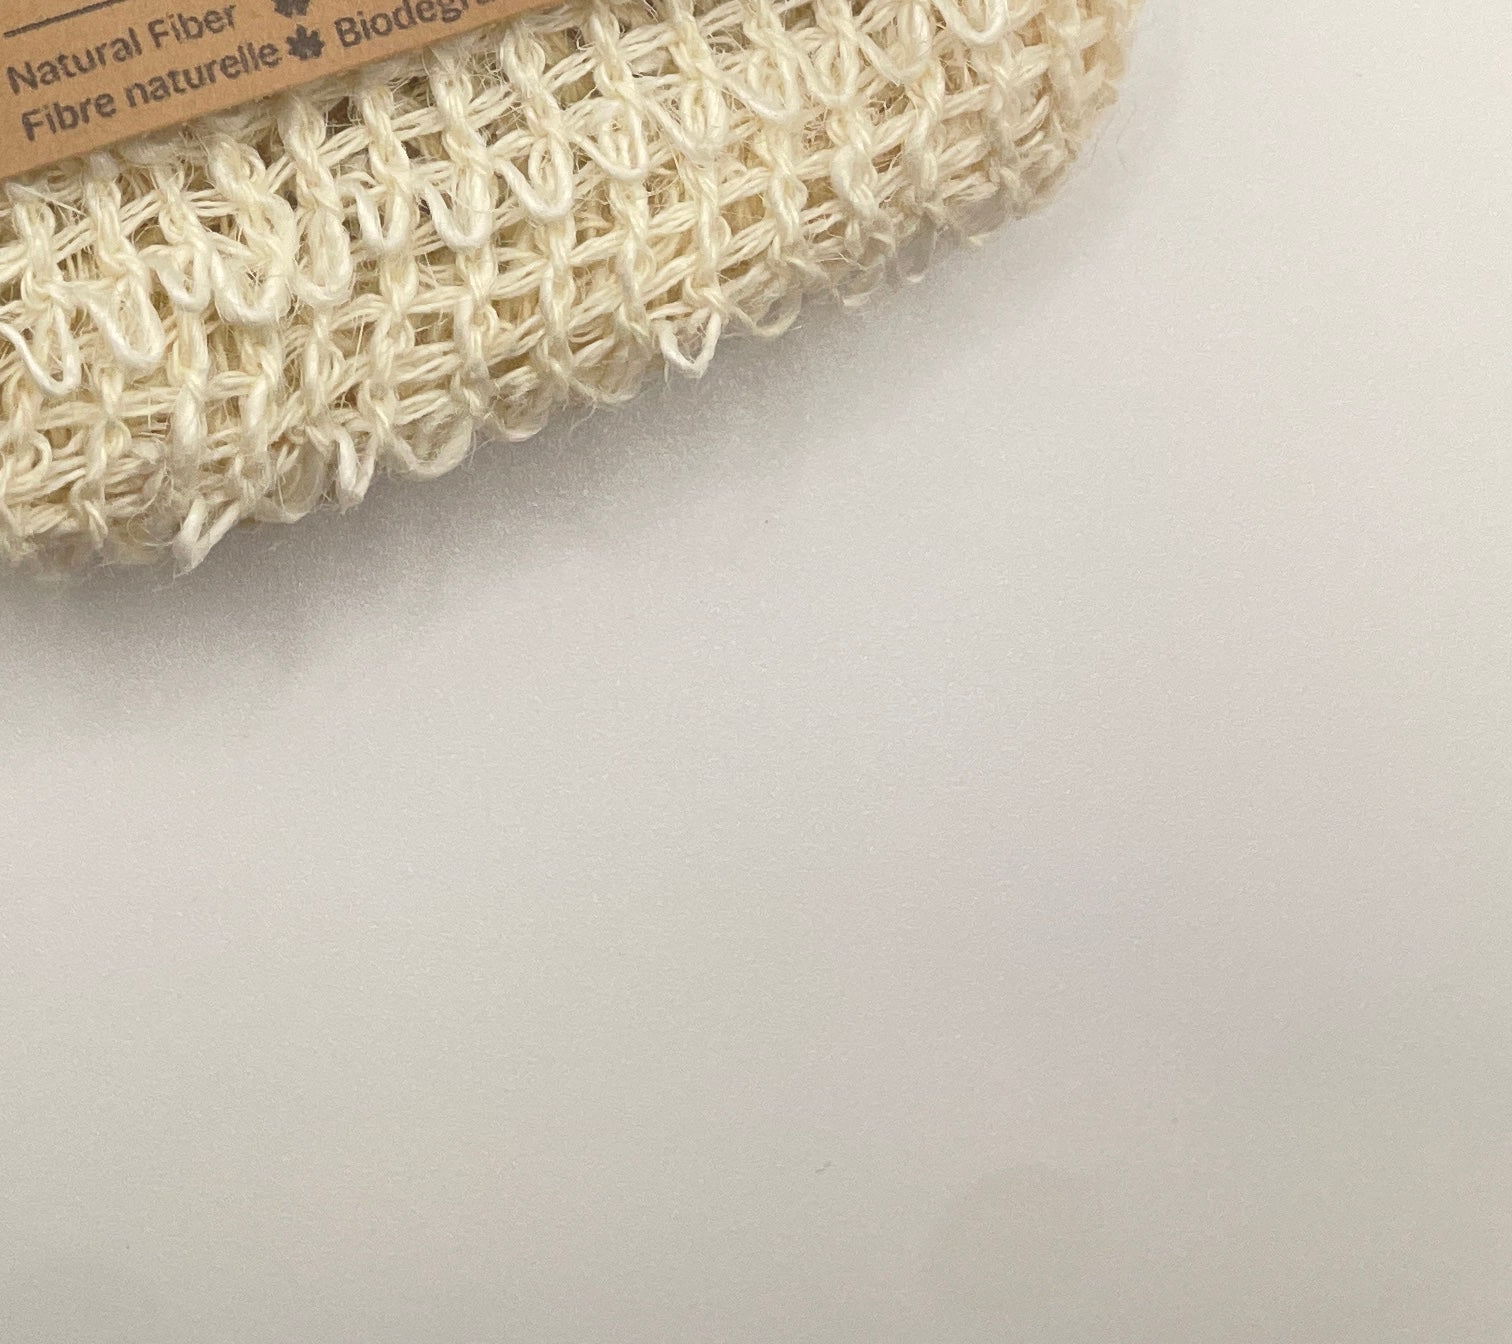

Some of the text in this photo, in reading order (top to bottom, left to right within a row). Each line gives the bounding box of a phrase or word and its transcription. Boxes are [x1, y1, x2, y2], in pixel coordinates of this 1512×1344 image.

[6, 27, 143, 95] Natural
[147, 4, 237, 50] Fiber
[21, 93, 117, 142] Fibre
[124, 39, 283, 110] naturelle
